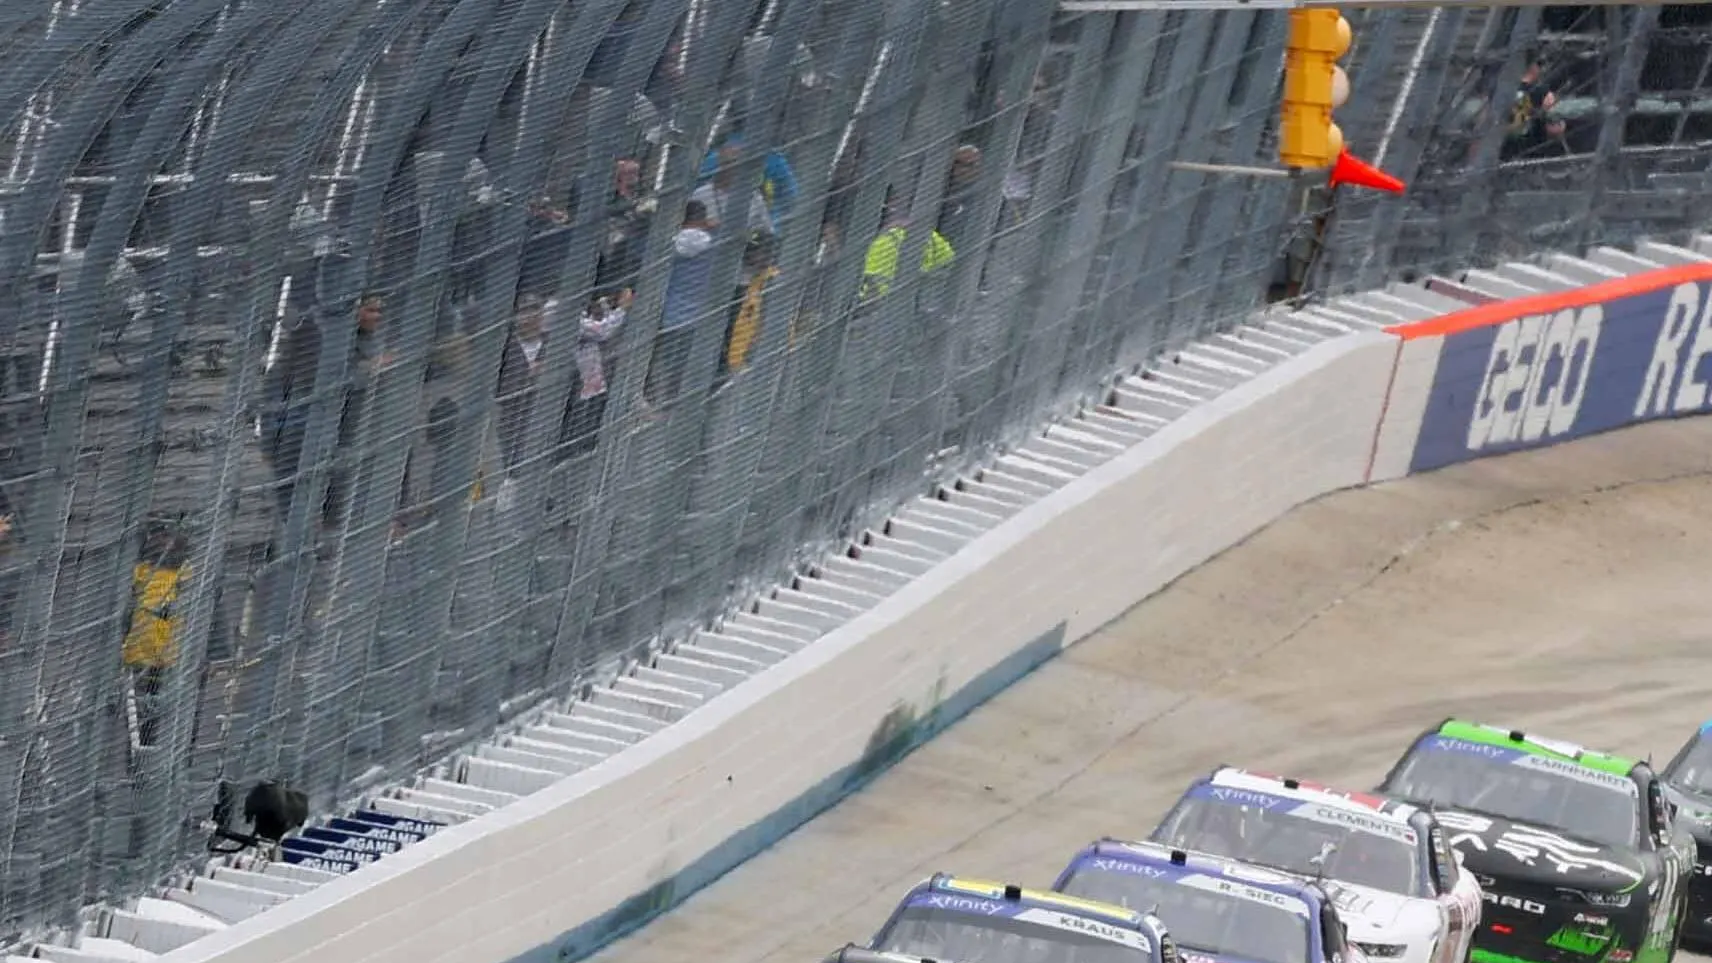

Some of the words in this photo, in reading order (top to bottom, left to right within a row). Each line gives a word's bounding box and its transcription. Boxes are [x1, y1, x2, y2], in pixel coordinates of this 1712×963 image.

[1464, 302, 1602, 450] GEICO
[927, 894, 1006, 916] xfinity
[1480, 891, 1547, 914] ARO
[1060, 915, 1126, 942] KRAUS
